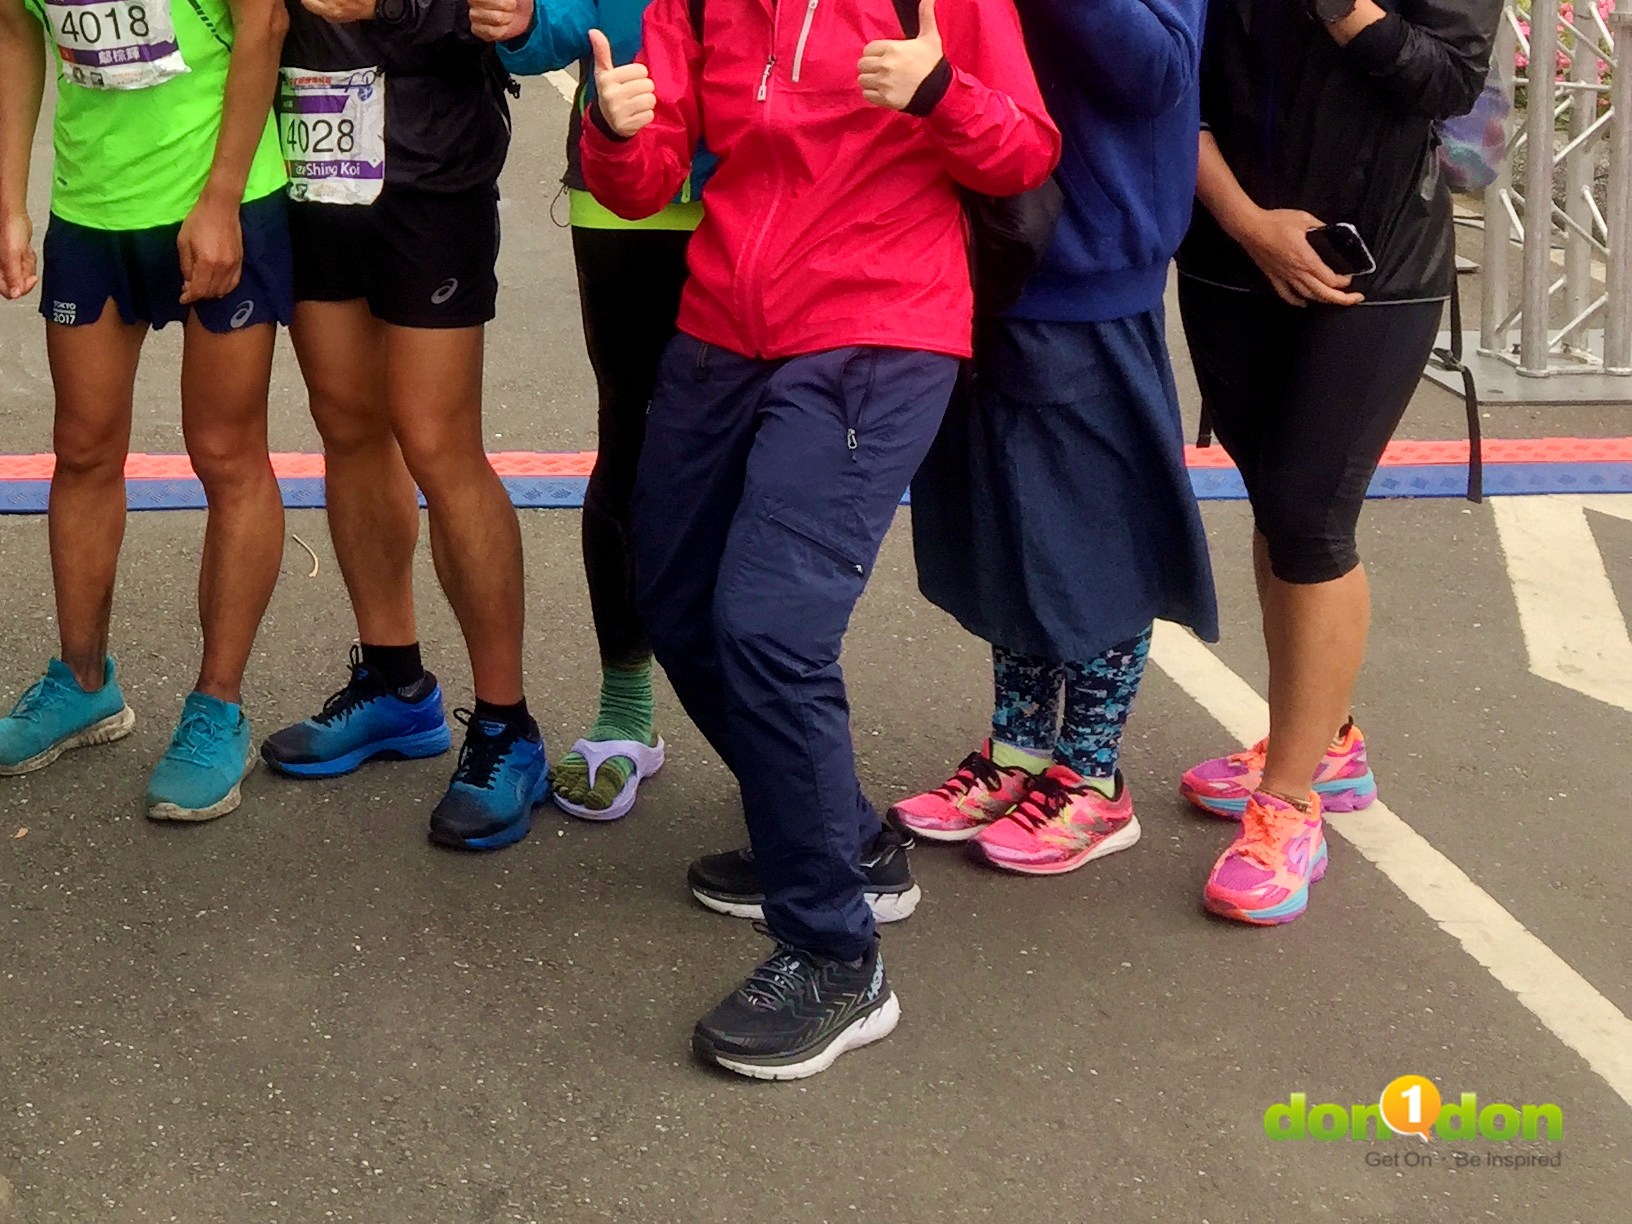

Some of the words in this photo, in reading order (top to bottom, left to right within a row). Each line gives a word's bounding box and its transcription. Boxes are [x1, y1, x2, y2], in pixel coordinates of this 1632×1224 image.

[61, 5, 150, 44] 4018
[286, 118, 355, 154] 4028
[340, 162, 361, 175] Koi
[53, 312, 76, 325] 2017
